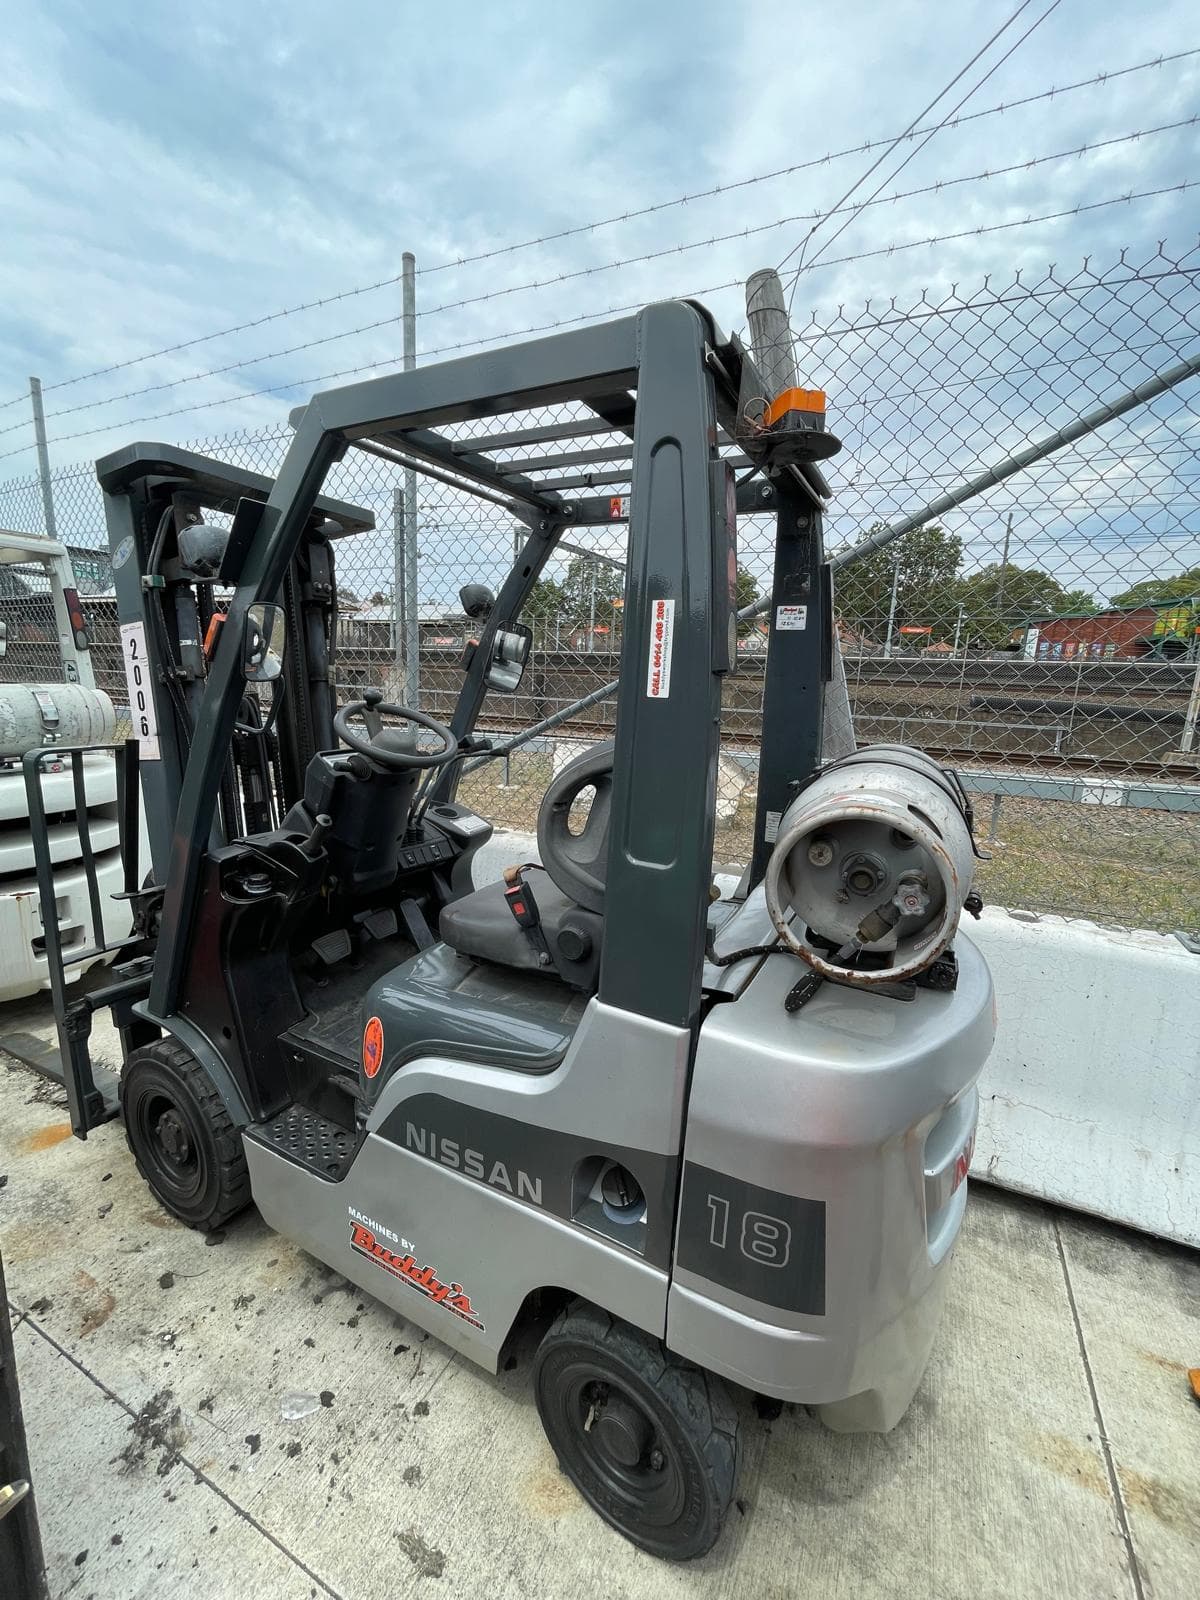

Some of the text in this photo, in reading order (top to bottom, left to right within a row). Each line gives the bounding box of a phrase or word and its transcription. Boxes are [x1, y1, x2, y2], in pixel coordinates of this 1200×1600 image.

[130, 638, 149, 736] 2006
[652, 670, 661, 696] CALL
[406, 1121, 543, 1205] NISSAN
[349, 1206, 415, 1252] MACHINES BY
[349, 1220, 479, 1316] Buddy's
[708, 1194, 791, 1268] 18
